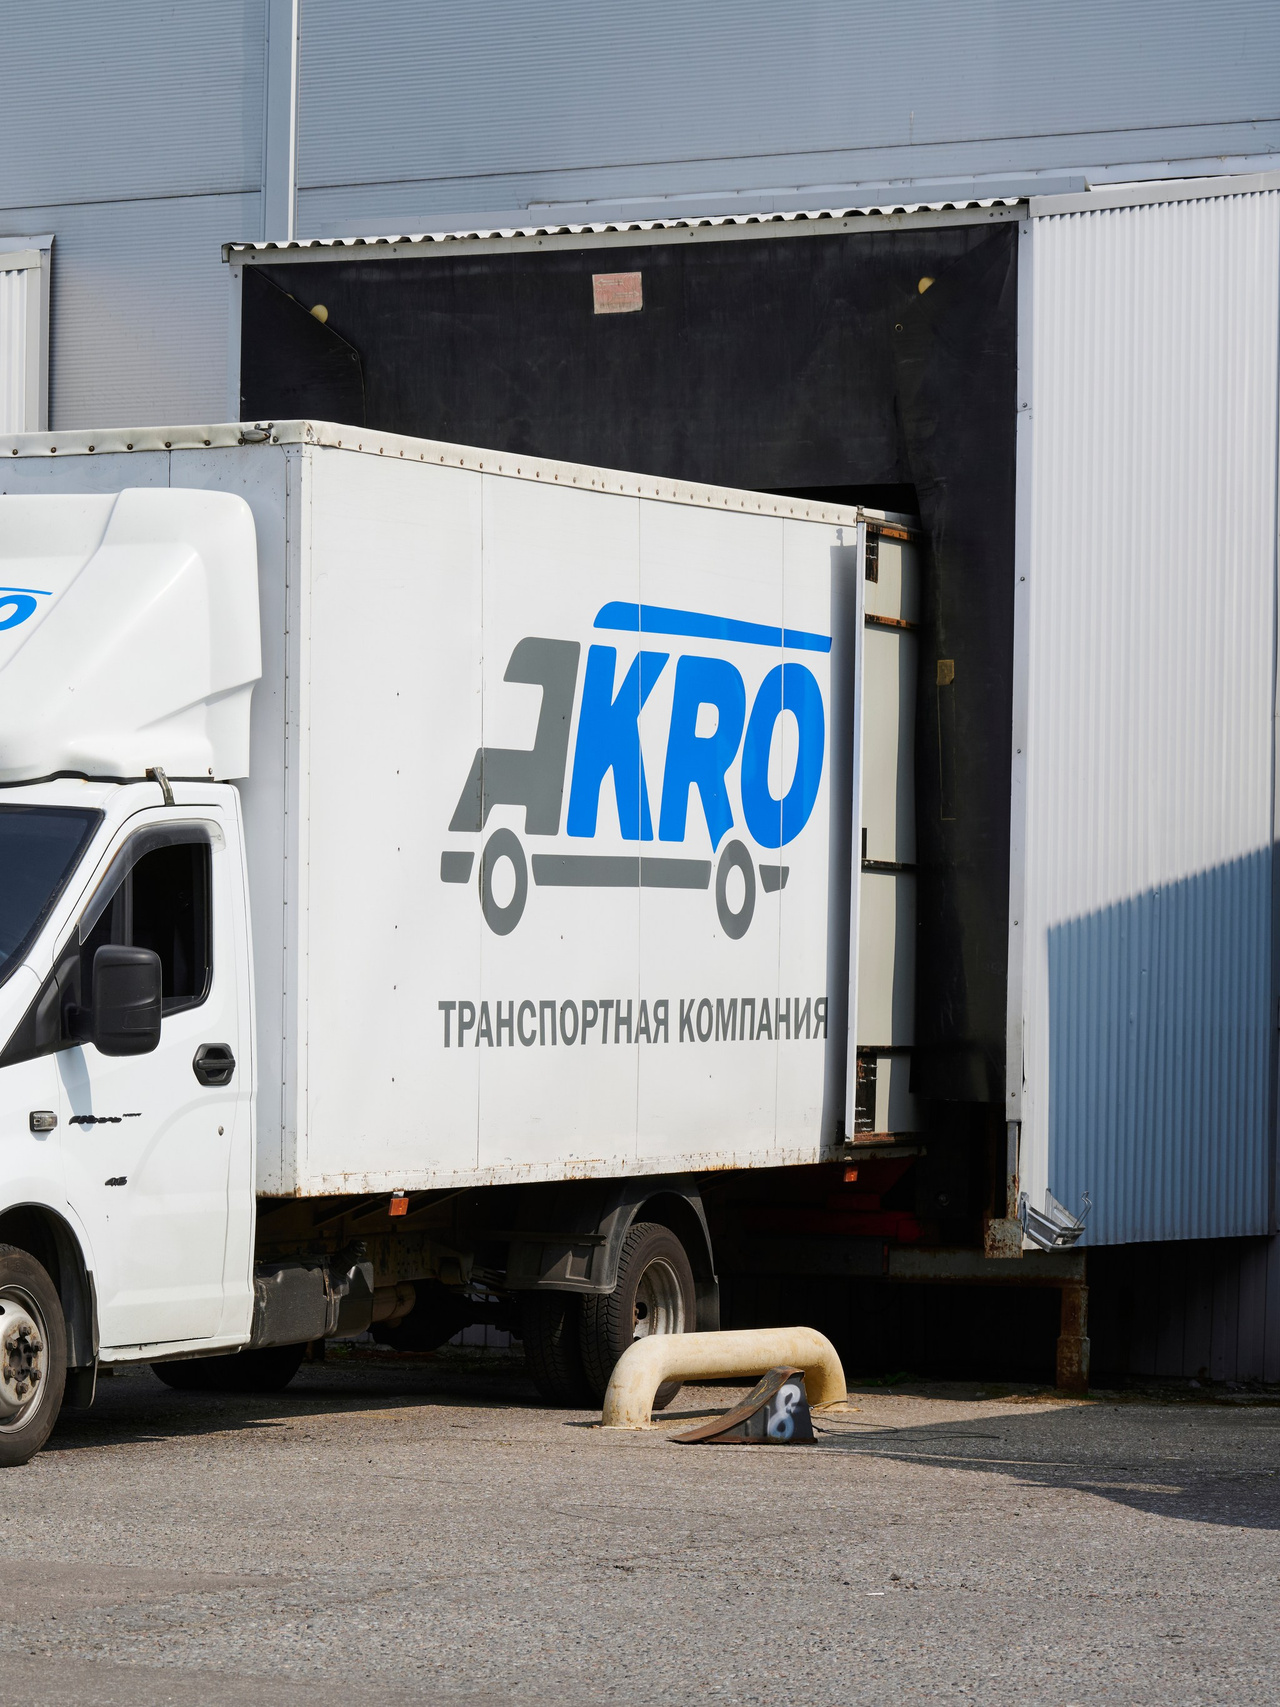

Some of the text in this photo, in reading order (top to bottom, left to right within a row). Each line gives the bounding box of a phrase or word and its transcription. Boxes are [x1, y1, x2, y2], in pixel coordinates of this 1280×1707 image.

[438, 996, 829, 1049] ТРАНСПОРТНАЯ КОМПАНИЯ
[768, 1384, 801, 1440] 8
